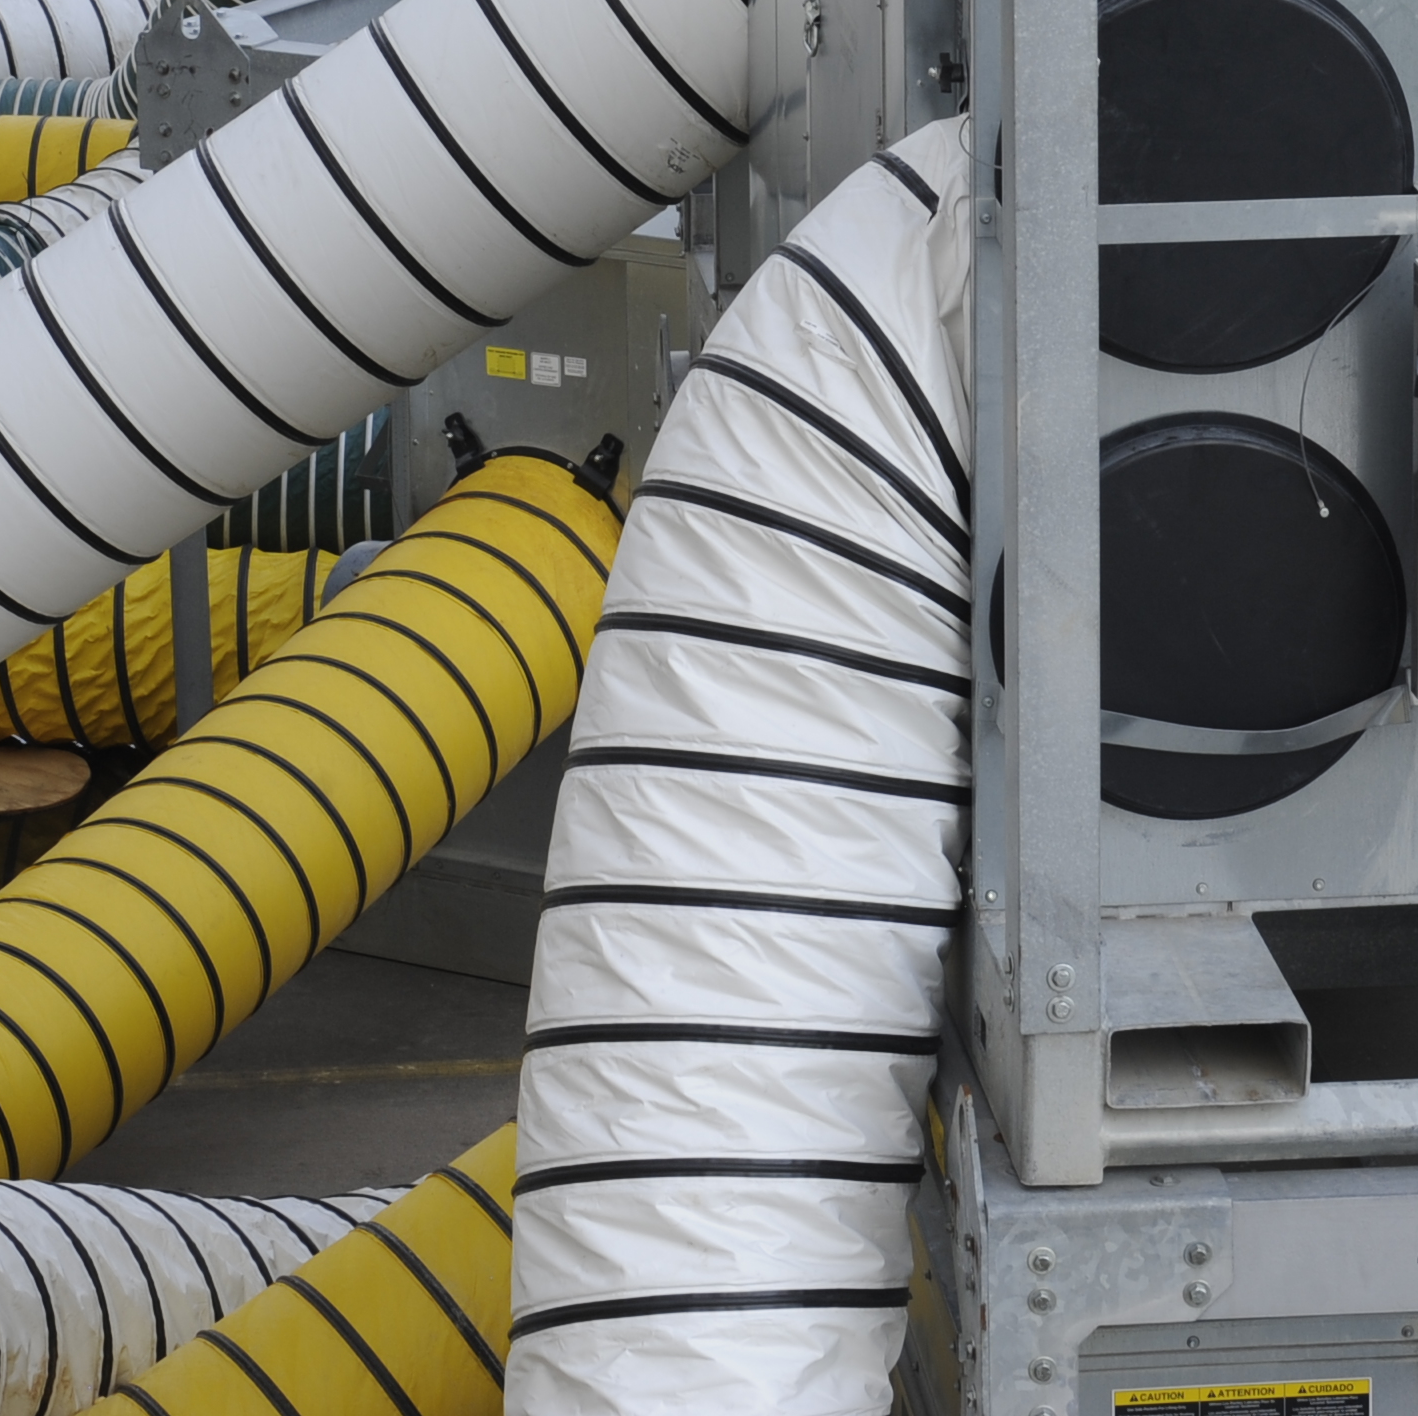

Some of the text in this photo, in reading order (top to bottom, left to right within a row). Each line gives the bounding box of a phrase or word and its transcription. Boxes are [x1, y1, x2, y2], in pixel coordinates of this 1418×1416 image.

[1139, 1383, 1354, 1402] CAUTION ATTENTION CUIDADO
